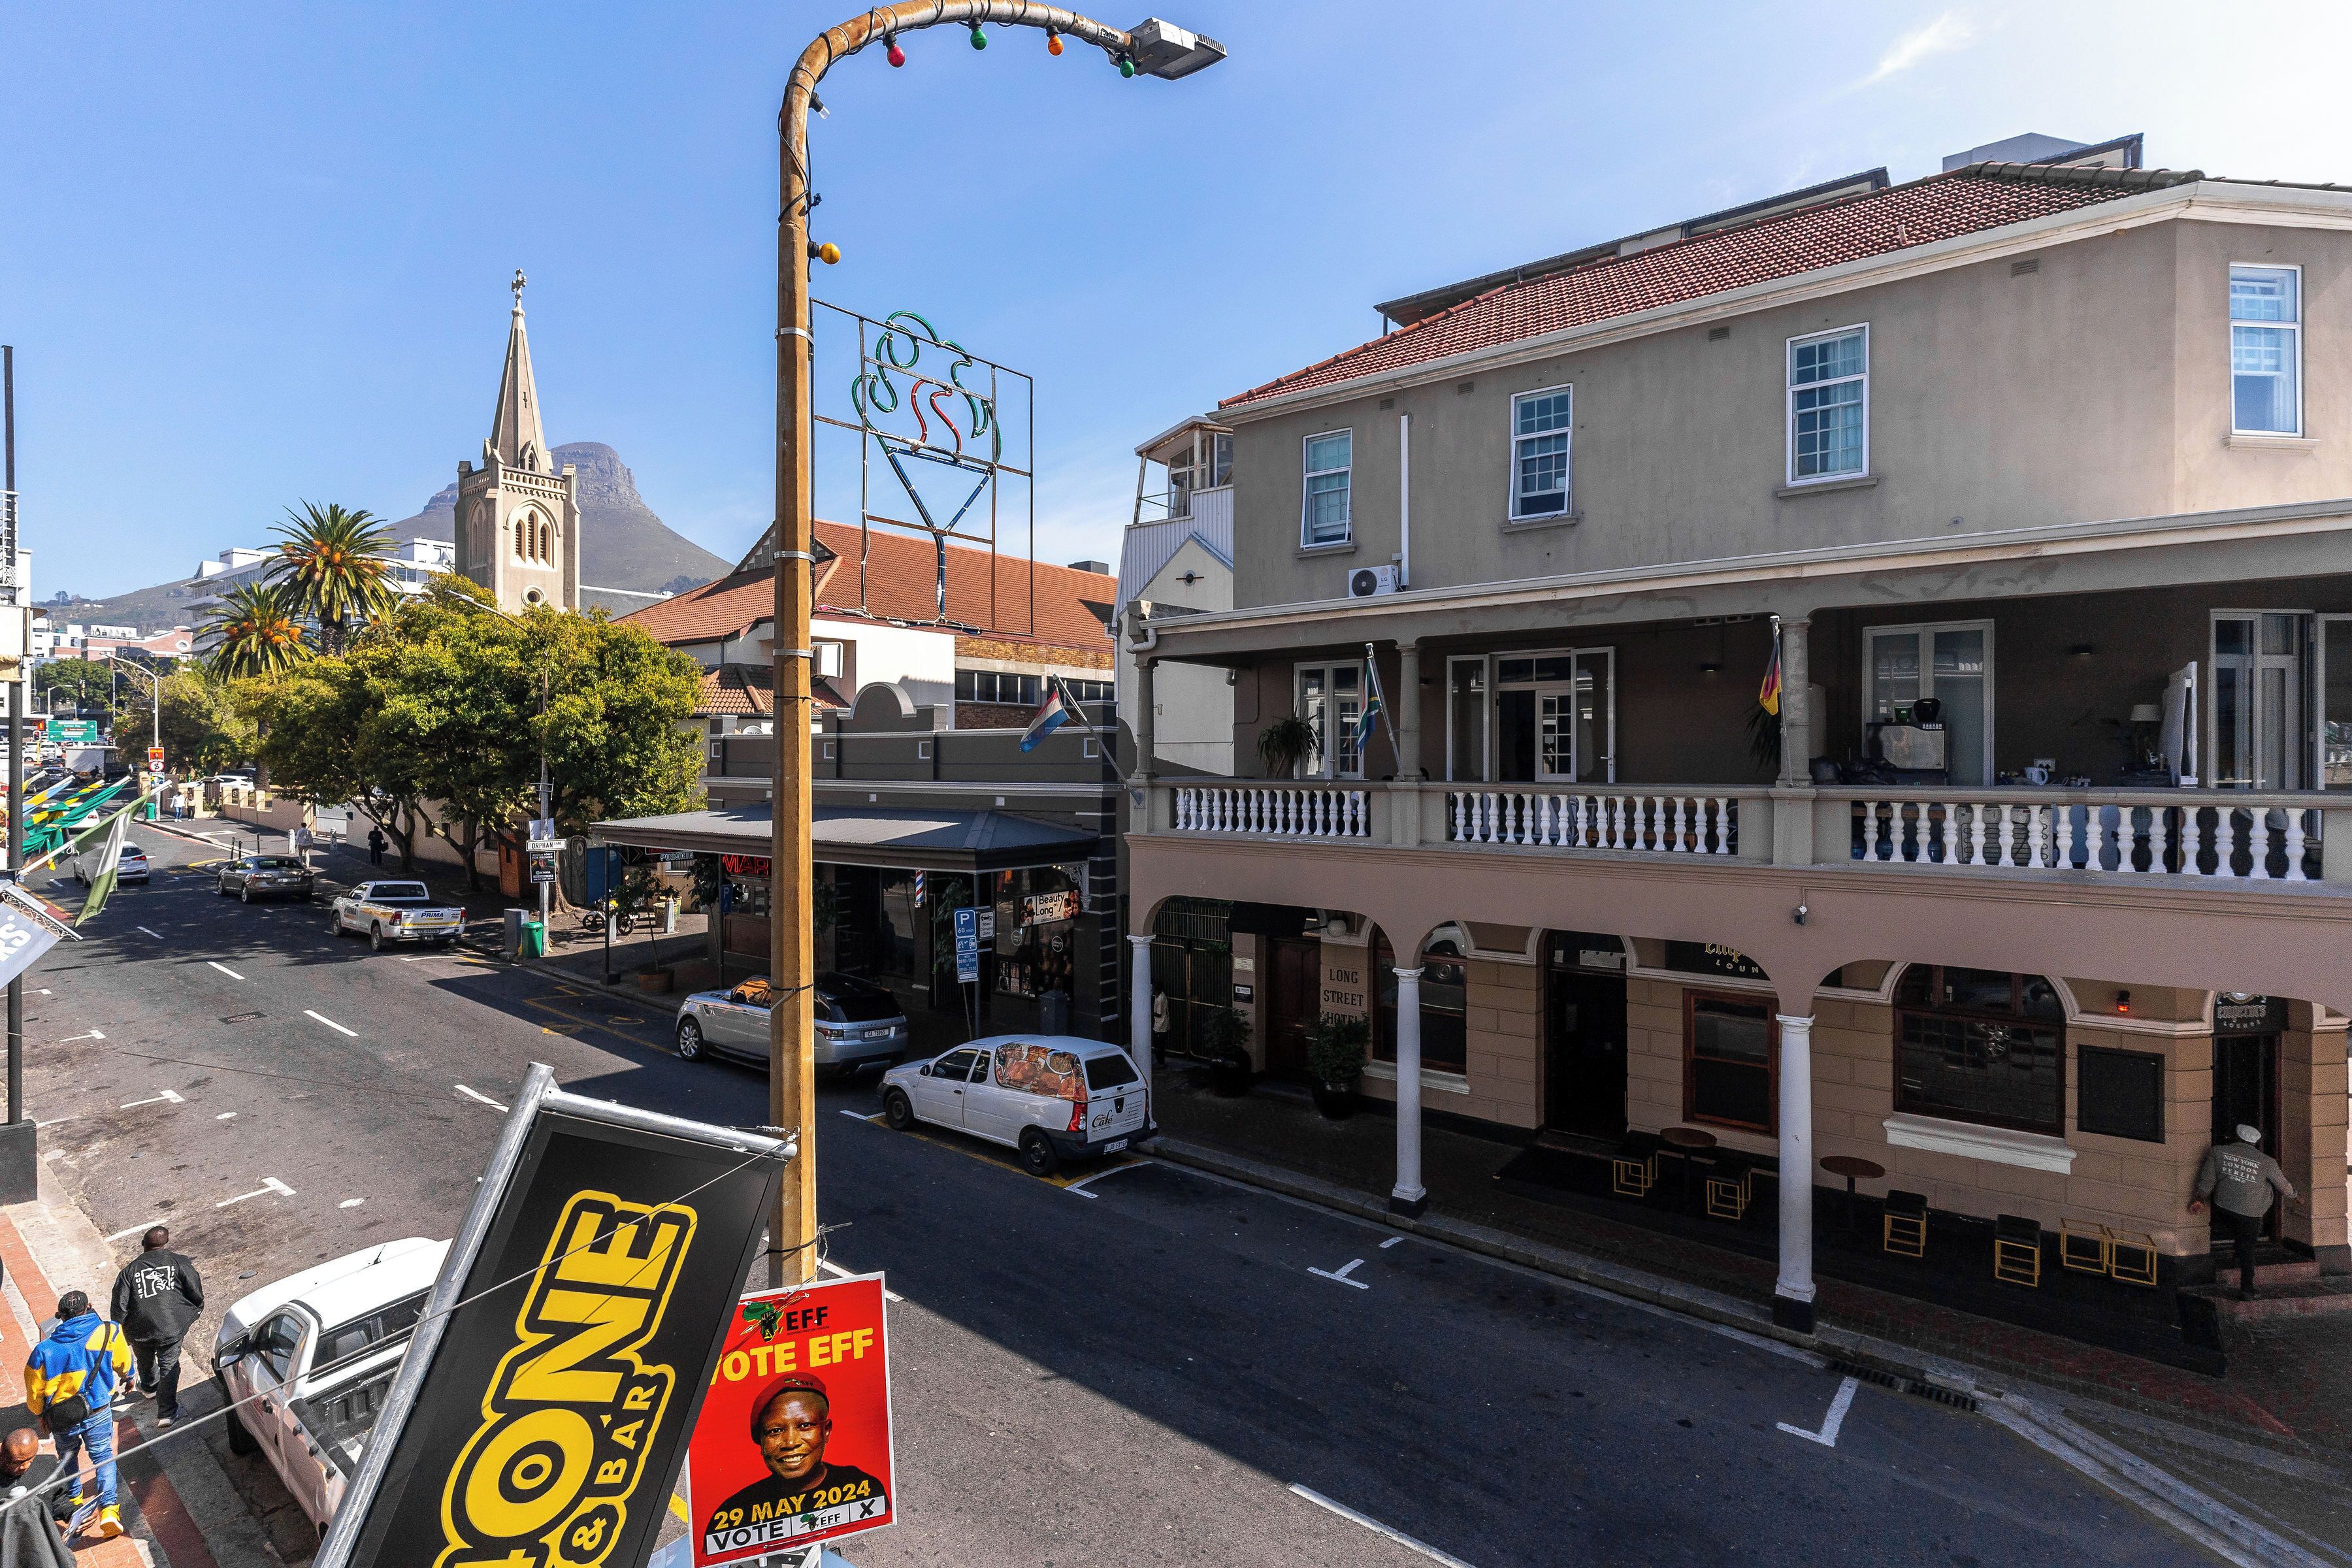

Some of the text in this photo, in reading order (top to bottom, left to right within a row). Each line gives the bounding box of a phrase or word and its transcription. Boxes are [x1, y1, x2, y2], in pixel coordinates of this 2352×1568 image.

[661, 852, 694, 862] PUSHKIN
[1035, 896, 1054, 917] Long
[1039, 893, 1065, 913] Beauty
[960, 913, 970, 924] P
[1329, 968, 1358, 984] LONG
[1323, 990, 1364, 1007] STREET
[1092, 1109, 1114, 1128] Café
[2223, 1161, 2258, 1175] LONDON
[2240, 1158, 2259, 1169] YORK
[2223, 1167, 2256, 1181] BERLIN
[135, 1272, 144, 1299] QUIET
[786, 1306, 828, 1331] EFF
[809, 1327, 874, 1367] EFF
[453, 1210, 680, 1568] ONE
[594, 1384, 658, 1486] BAR
[713, 1479, 871, 1531] 29 MAY 2024
[711, 1519, 784, 1551] VOTE
[821, 1512, 841, 1526] EFF
